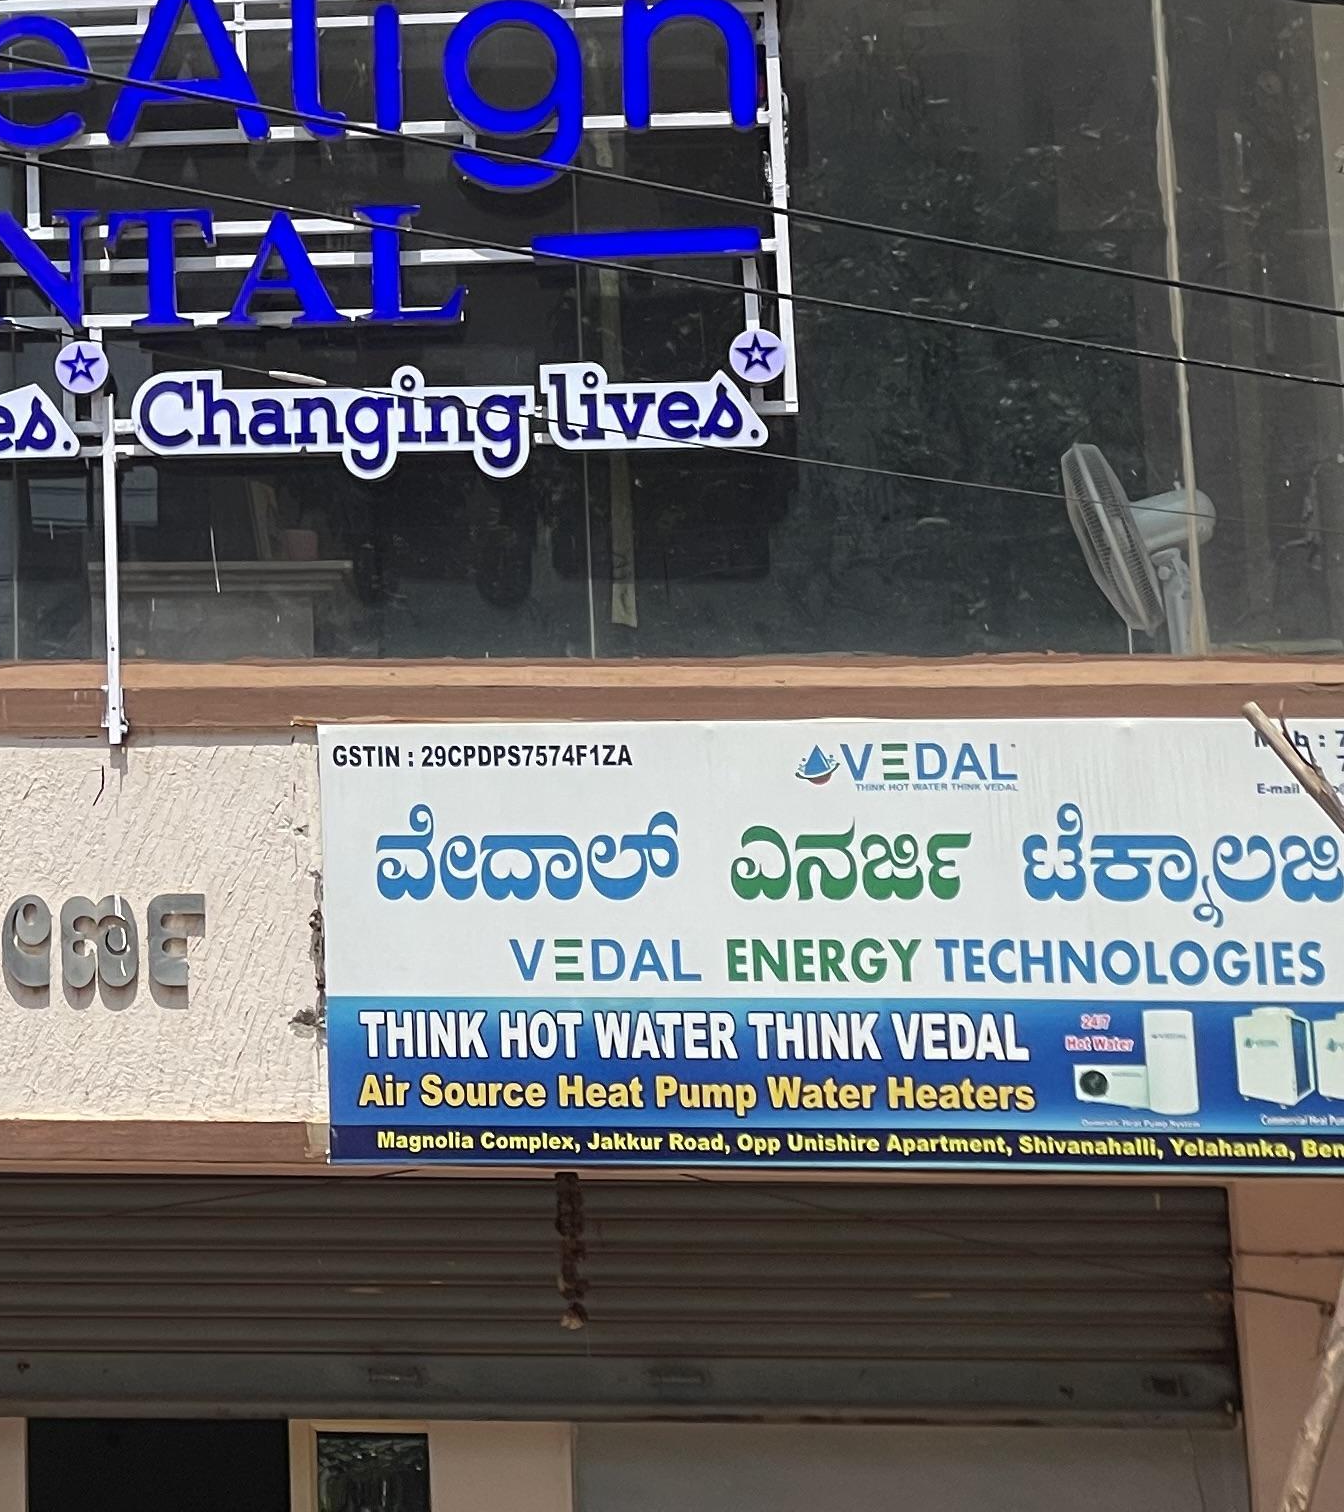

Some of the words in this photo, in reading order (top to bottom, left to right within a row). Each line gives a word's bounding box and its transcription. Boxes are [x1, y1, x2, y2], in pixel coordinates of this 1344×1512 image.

[140, 371, 528, 470] Changing
[548, 371, 760, 443] lives.
[332, 744, 400, 768] GSTIN
[421, 744, 634, 768] 29CPDPS7574F1ZA
[839, 743, 1018, 781] VEDAL
[855, 782, 886, 792] THINK
[888, 782, 909, 792] HOT
[912, 782, 948, 792] WATER
[952, 782, 981, 792] THINK
[985, 782, 1019, 792] VEDAL
[1256, 782, 1301, 794] E-mail
[376, 803, 680, 902] ವೇದಾಲ್
[509, 938, 703, 982] VEDAL
[726, 938, 922, 984] ENERGY
[935, 938, 1327, 986] TECHNOLOGIES
[359, 1010, 488, 1059] THINK
[499, 1010, 583, 1059] HOT
[594, 1010, 736, 1060] WATER
[748, 1011, 883, 1061] THINK
[891, 1012, 1030, 1062] VEDAL
[359, 1074, 409, 1107] Air
[420, 1076, 547, 1108] Source
[558, 1075, 644, 1108] Heat
[656, 1076, 757, 1116] Pump
[767, 1076, 876, 1110] Water
[888, 1076, 1036, 1112] Heaters
[377, 1131, 474, 1153] Magnolia
[480, 1131, 581, 1154] Complex,
[587, 1132, 664, 1152] Jakkur
[669, 1133, 731, 1156] Road,
[737, 1134, 781, 1155] Opp
[787, 1134, 880, 1153] Unishire
[886, 1134, 1013, 1157] Apartment,
[1018, 1135, 1164, 1160] Shivanahalli,
[1168, 1137, 1297, 1162] Yelahanka,
